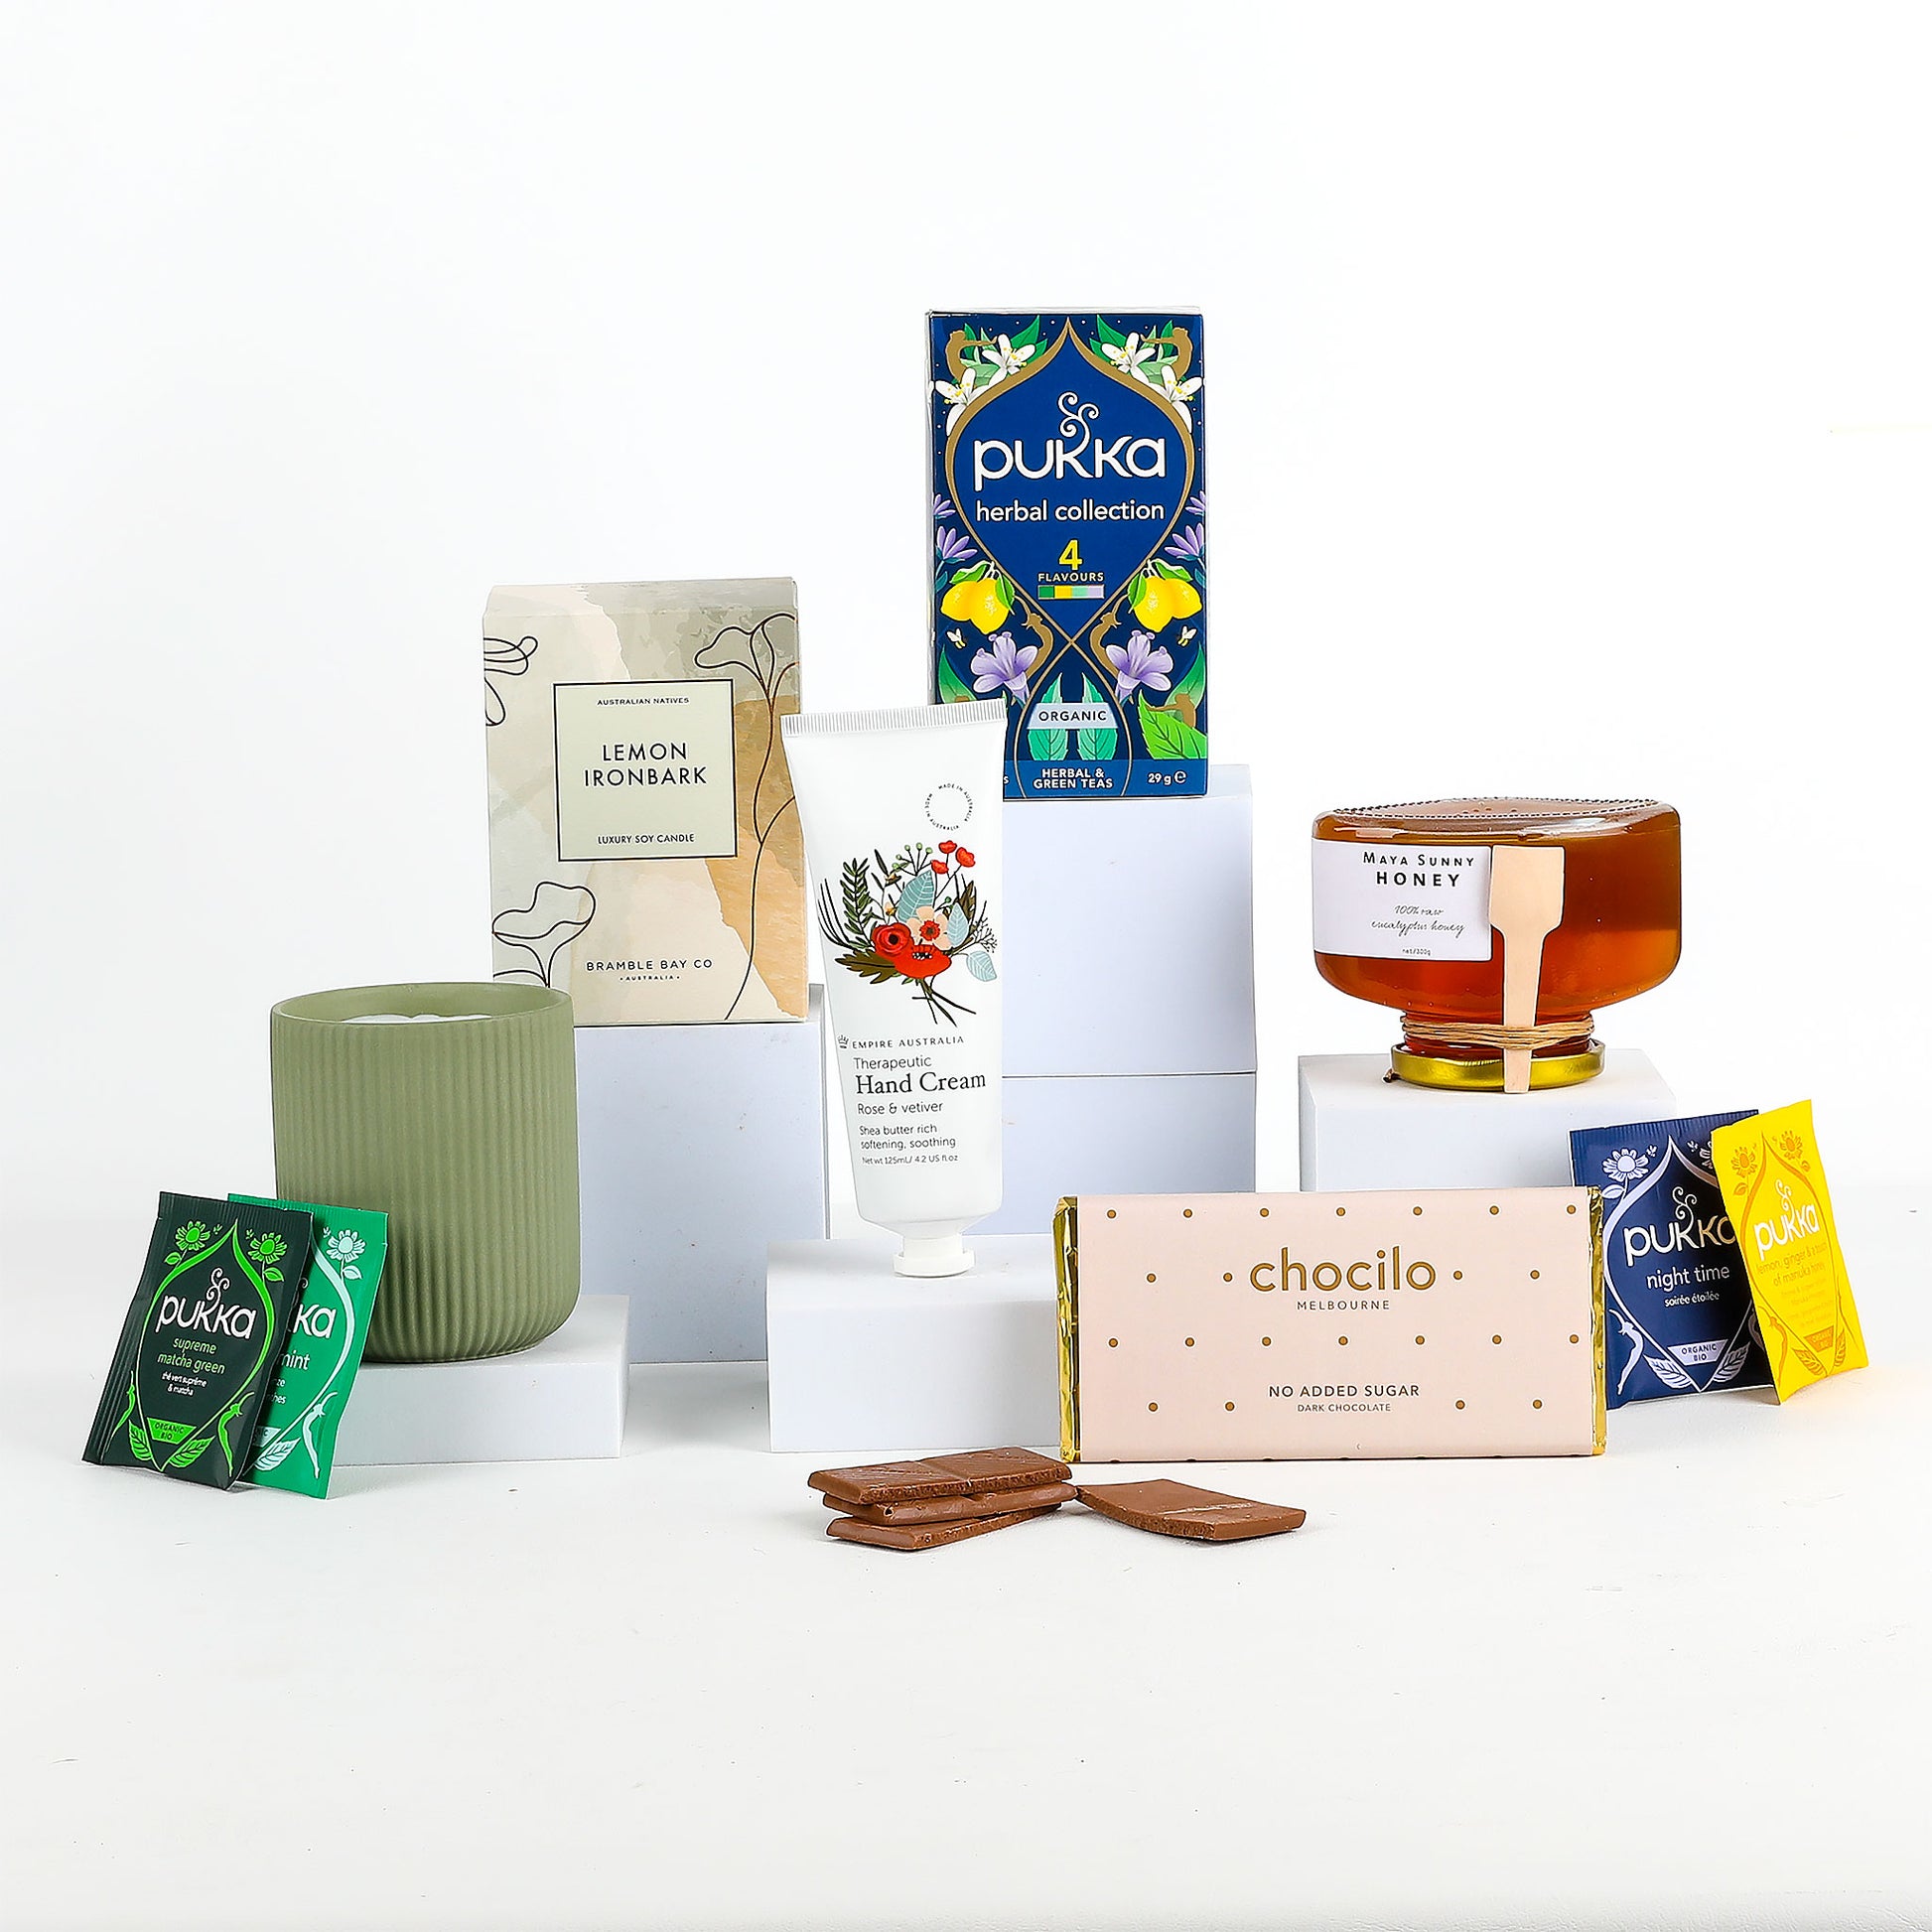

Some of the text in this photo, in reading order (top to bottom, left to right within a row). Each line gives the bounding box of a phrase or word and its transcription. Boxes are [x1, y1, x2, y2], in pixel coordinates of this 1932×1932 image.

[974, 392, 1166, 491] pukka
[977, 499, 1165, 521] herbal collection
[1058, 539, 1083, 571] 4
[1037, 573, 1104, 582] FLAVOURS
[1038, 711, 1107, 722] ORGANIC
[603, 743, 687, 761] LEMON
[584, 766, 707, 787] IRONBARK
[1041, 768, 1105, 778] HERBAL &
[1148, 772, 1162, 784] 29
[1164, 775, 1172, 784] g
[1034, 778, 1113, 789] GREEN TEAS
[598, 835, 632, 844] LUXURY
[656, 834, 695, 843] CANDLE
[1376, 871, 1460, 888] HONEY
[1395, 905, 1420, 914] 100%
[1371, 919, 1465, 939] eucalyptus honey
[586, 959, 713, 971] BRAMBLE BAY CO
[852, 1035, 965, 1049] EMPIRE AUSTRALIA
[853, 1055, 933, 1071] Therapeutic
[856, 1071, 986, 1094] Hand Cream
[858, 1101, 943, 1115] Rose & vetiver
[859, 1123, 937, 1136] Shea butter rich
[861, 1137, 956, 1152] softening, soothing
[928, 1154, 940, 1163] US
[1753, 1178, 1820, 1262] pukka
[1249, 1246, 1437, 1292] chocilo
[1646, 1264, 1730, 1293] night time
[155, 1267, 257, 1339] pukka
[1297, 1300, 1390, 1311] MELBOURNE
[173, 1337, 217, 1354] supreme
[1681, 1343, 1717, 1355] ORGANIC
[157, 1352, 225, 1375] matcha green
[1268, 1384, 1420, 1398] NO ADDED SUGAR
[1297, 1403, 1392, 1412] DARK CHOCOLATE
